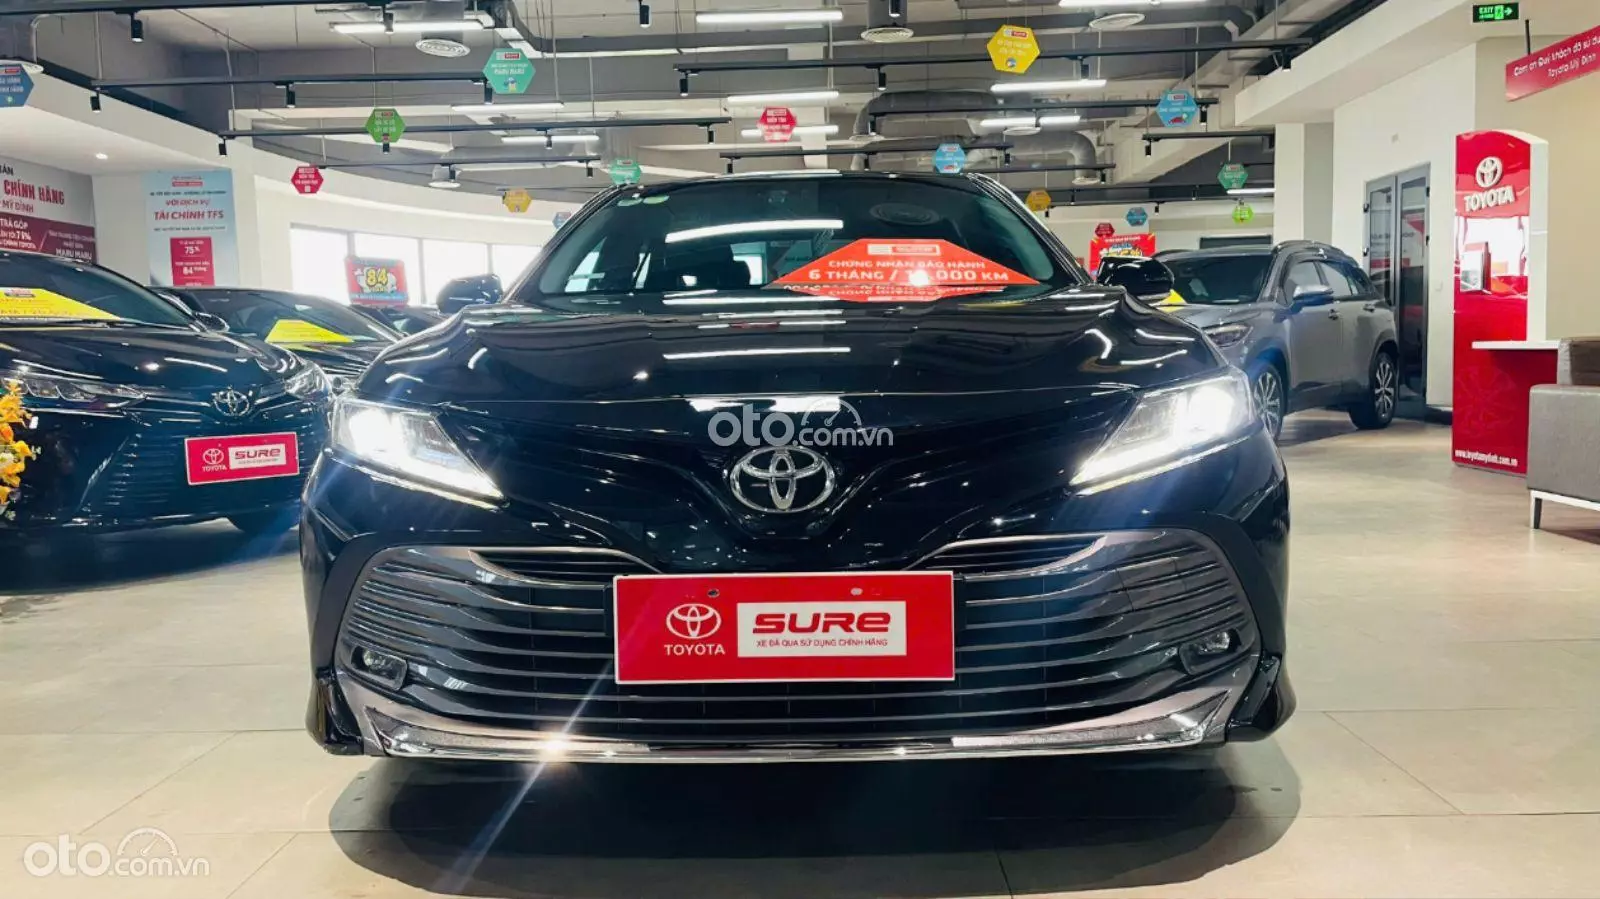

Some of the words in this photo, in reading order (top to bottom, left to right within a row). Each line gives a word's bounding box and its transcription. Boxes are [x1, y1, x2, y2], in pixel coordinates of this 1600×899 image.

[1479, 6, 1494, 14] EXIT
[1548, 63, 1570, 77] Toyota
[3, 179, 36, 200] CHÍNH
[1463, 185, 1516, 212] TOYOTA
[207, 209, 224, 219] TFS
[366, 267, 388, 287] 84
[808, 268, 821, 280] 6
[826, 267, 884, 280] THÁNG
[903, 268, 977, 281] 1000
[981, 271, 1009, 281] KM
[202, 464, 227, 473] TOYOTA
[664, 643, 725, 656] TOYOTA
[756, 638, 768, 648] XE
[781, 638, 799, 647] QUA
[814, 638, 837, 649] DỤNG
[838, 637, 864, 647] CHÍNH
